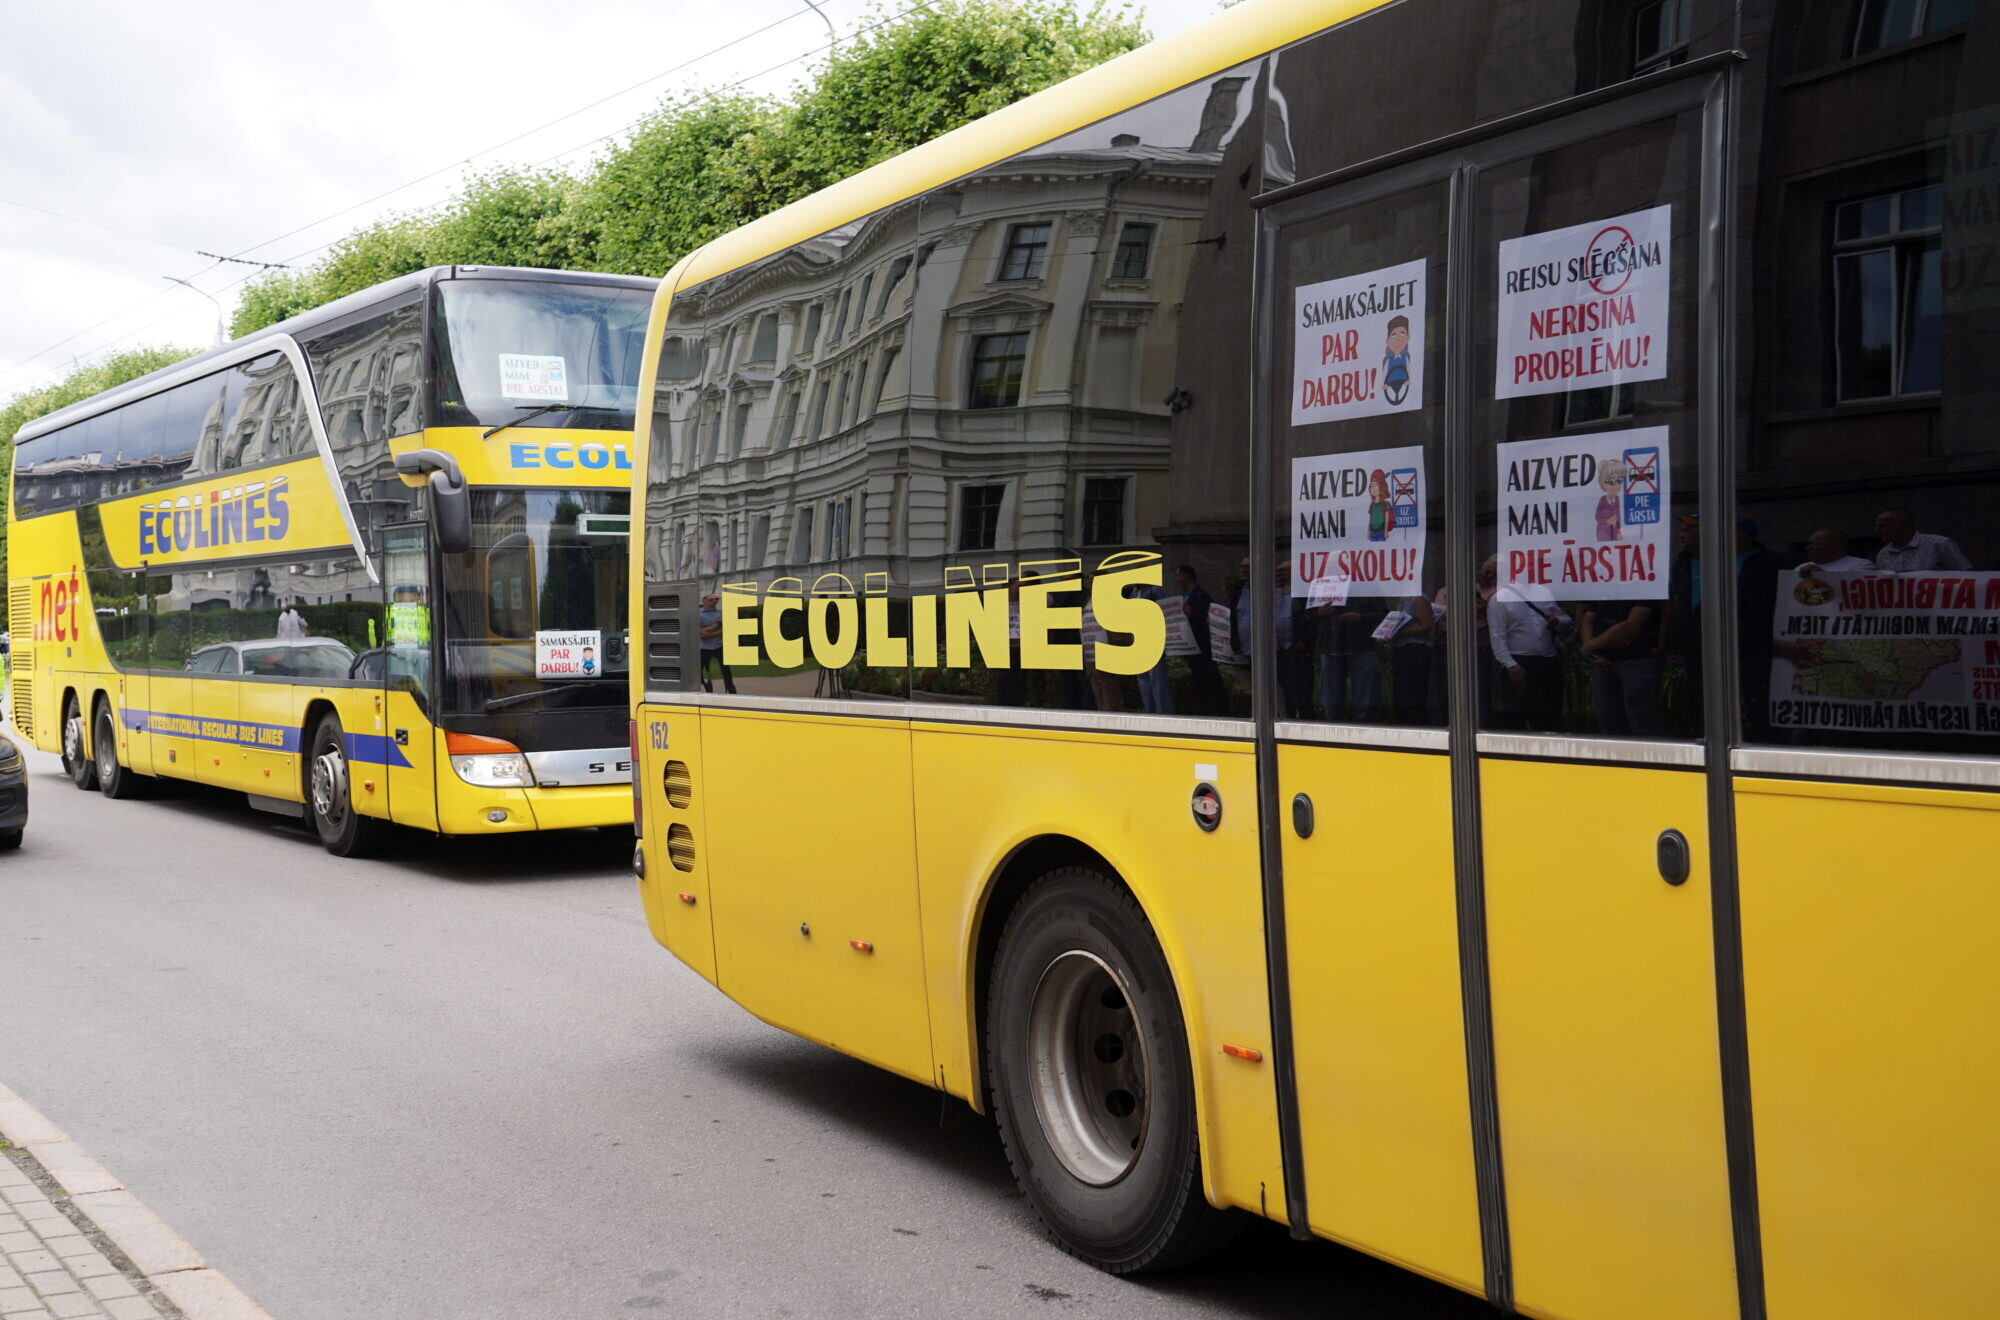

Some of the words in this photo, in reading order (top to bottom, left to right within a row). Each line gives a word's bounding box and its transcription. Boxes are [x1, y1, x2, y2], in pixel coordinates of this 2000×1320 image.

[1506, 261, 1561, 295] REISU
[1567, 240, 1662, 283] SLĒGŠANA
[1302, 279, 1418, 328] SAMAKSĀJIET
[1529, 294, 1636, 341] NERISINA
[1321, 329, 1359, 365] PAR
[1514, 335, 1651, 384] PROBLĒMU!
[1302, 367, 1377, 410] DARBU!
[509, 441, 633, 469] ECOL
[1507, 453, 1596, 492] AIZVED
[1299, 467, 1368, 501] AIZVED
[1634, 495, 1649, 507] PIE
[140, 476, 290, 555] ECOLINES
[1300, 509, 1346, 540] MANI
[1400, 506, 1410, 516] UZ
[1508, 501, 1568, 536] MANI
[1628, 508, 1656, 522] ĀRSTA
[1299, 551, 1331, 583] UZ
[1338, 547, 1417, 582] SKOLU!
[1509, 549, 1552, 585] PIE
[1562, 539, 1656, 583] ĀRSTA!
[34, 564, 78, 642] .net
[722, 550, 1167, 675] ECOLINES
[540, 635, 596, 647] SAMAKSĀJIET
[551, 648, 570, 659] PAR
[541, 662, 579, 674] DARBU!
[147, 715, 200, 739] INTERNATIONAL
[202, 721, 238, 740] REGULAR
[239, 725, 256, 743] BUS
[258, 728, 284, 746] LINES
[649, 721, 669, 749] 152
[589, 761, 631, 773] SE
